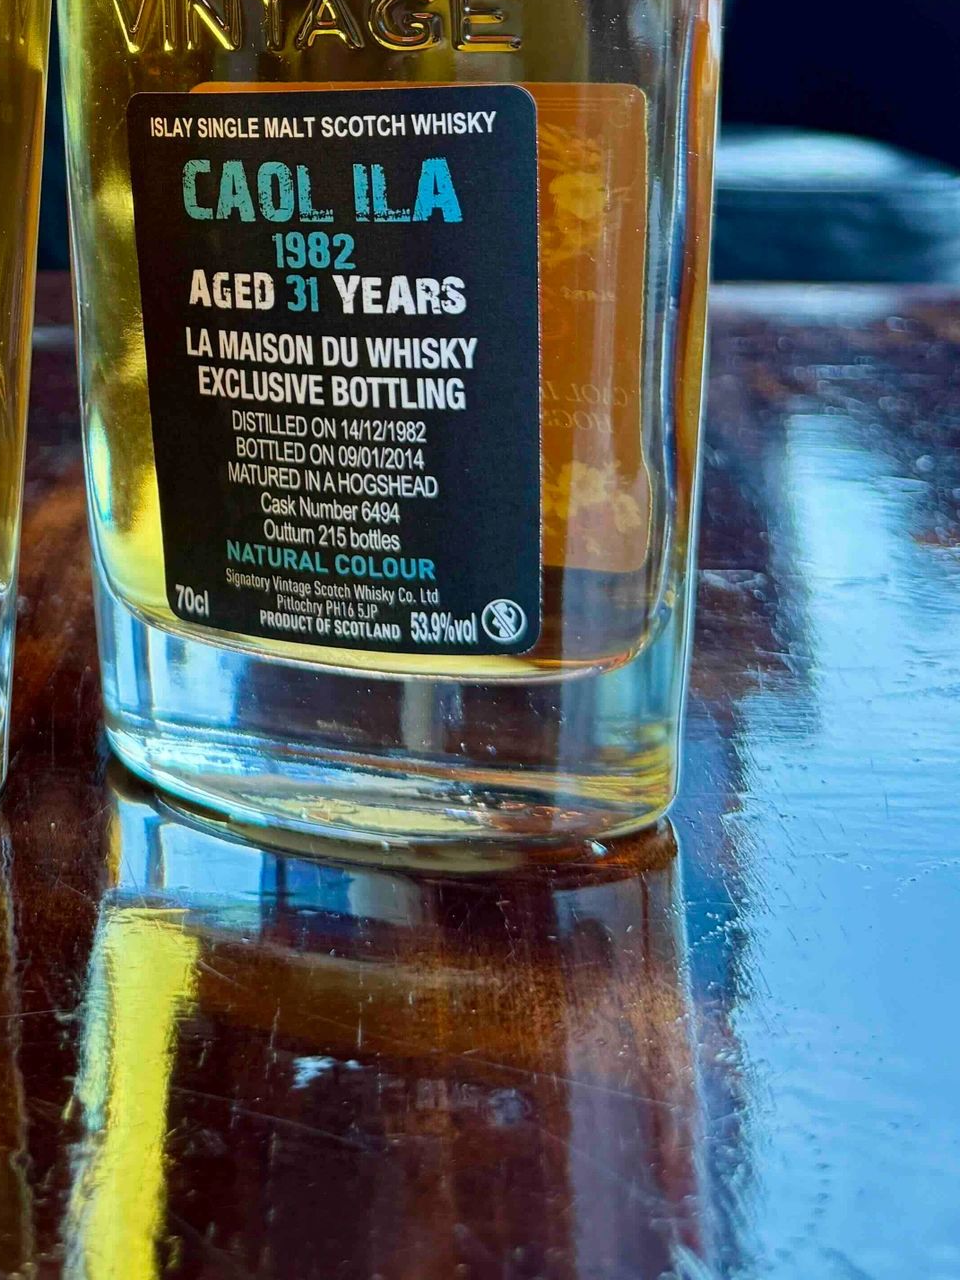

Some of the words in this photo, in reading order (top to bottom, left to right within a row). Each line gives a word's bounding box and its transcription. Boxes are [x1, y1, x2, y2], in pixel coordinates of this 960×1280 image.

[150, 117, 193, 138] ISLAY
[198, 117, 260, 138] SINGLE
[265, 116, 315, 138] MALT
[321, 114, 406, 137] SCOTCH
[411, 111, 497, 136] WHISKY
[182, 158, 334, 223] CAOL
[353, 157, 463, 223] ILA
[272, 231, 356, 270] 1982
[189, 269, 275, 310] AGED
[286, 274, 320, 313] 31
[332, 274, 468, 315] YEARS
[185, 326, 213, 357] LA
[219, 328, 314, 365] MAISON
[321, 336, 358, 367] DU
[365, 336, 478, 369] WHISKY
[198, 366, 325, 405] EXCLUSIVE
[331, 376, 467, 410] BOTTLING
[232, 409, 308, 438] DISTILLED
[312, 417, 336, 439] ON
[340, 420, 427, 444] 14/12/1982
[236, 436, 306, 464] BOTTLED
[309, 444, 335, 466] ON
[338, 446, 424, 470] 09/01/2014
[228, 461, 301, 489] MATURED
[305, 470, 322, 490] IN
[323, 471, 336, 491] A
[339, 472, 438, 498] HOGSHEAD
[260, 492, 297, 515] Cask
[300, 495, 358, 521] Number
[361, 501, 400, 524] 6494
[318, 525, 347, 547] 215
[350, 526, 401, 551] bottles
[226, 540, 329, 574] NATURAL
[334, 553, 436, 580] COLOUR
[175, 585, 209, 616] 70cl
[225, 568, 270, 592] Signatory
[272, 575, 312, 596] Vintage
[314, 580, 352, 599] Scotch
[353, 584, 396, 606] Whisky
[397, 588, 416, 603] Co.
[419, 588, 439, 604] Ltd
[276, 594, 324, 618] Pitlochry
[325, 602, 355, 617] PH16
[357, 604, 378, 620] 5JP
[259, 609, 314, 633] PRODUCT
[315, 617, 332, 634] OF
[334, 619, 401, 641] SCOTLAND
[410, 611, 478, 645] 53.9%vol
